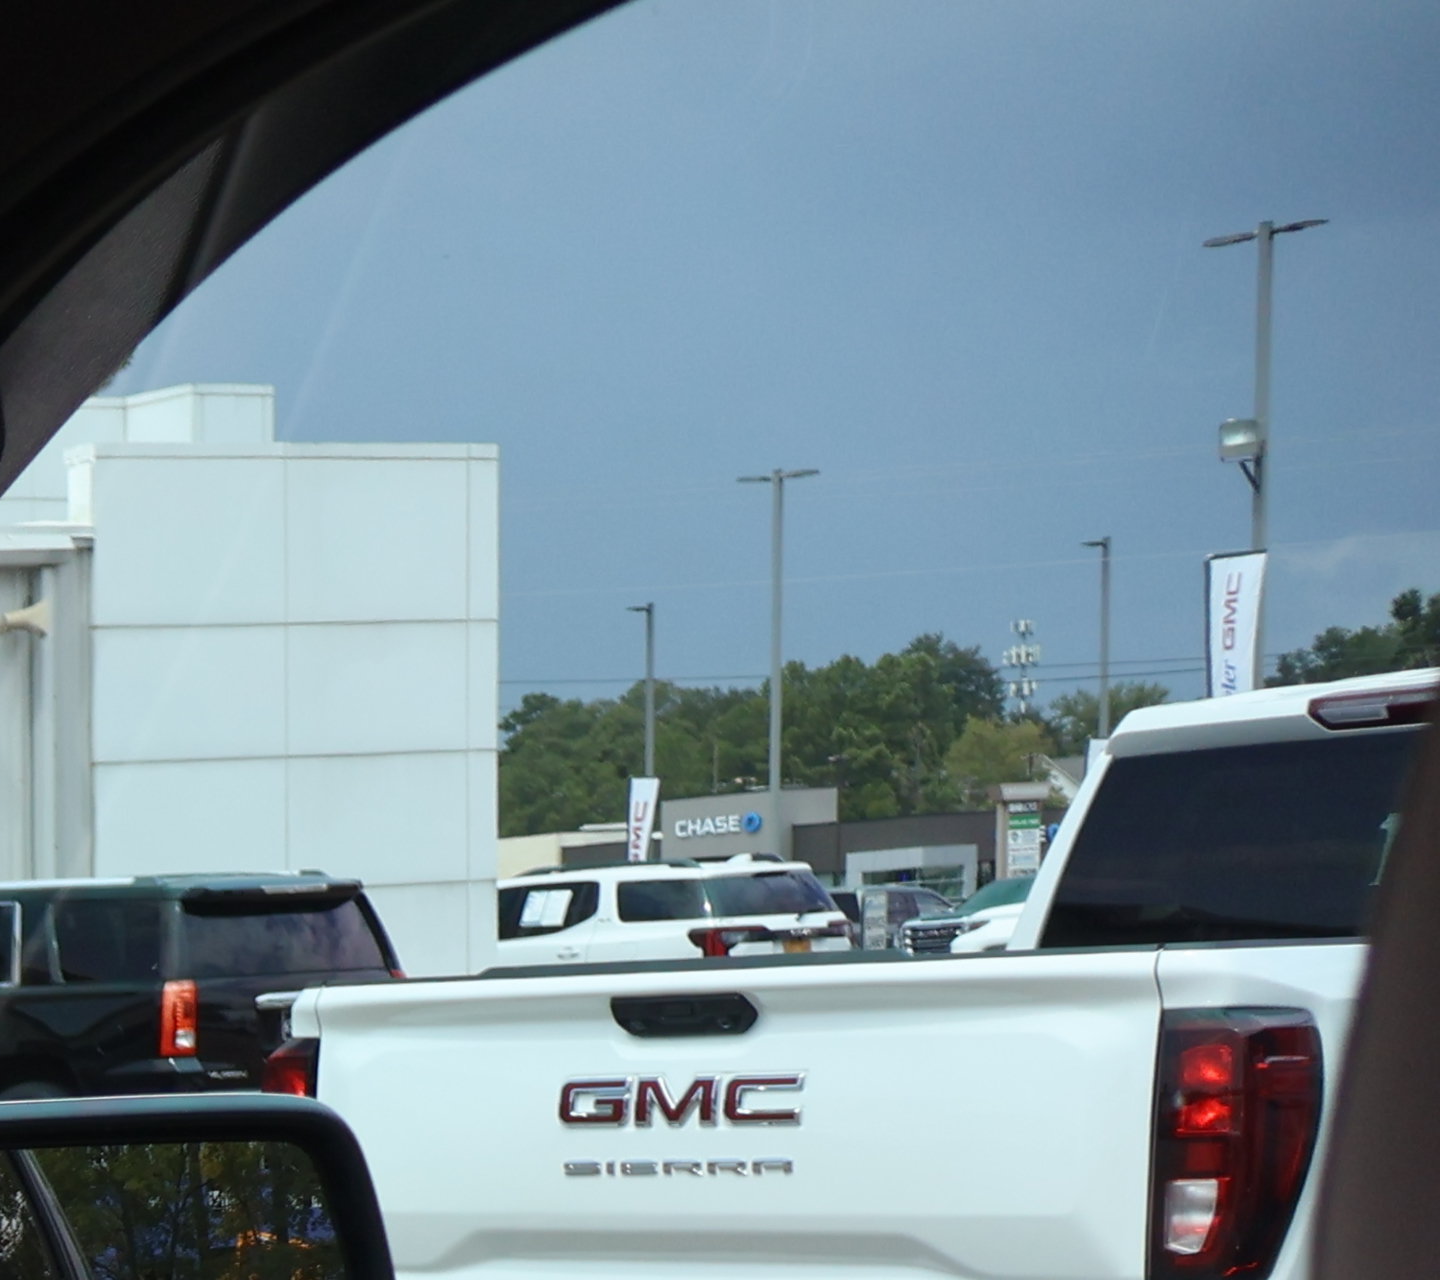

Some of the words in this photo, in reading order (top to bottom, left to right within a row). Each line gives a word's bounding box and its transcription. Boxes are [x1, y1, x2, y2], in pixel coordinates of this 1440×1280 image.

[1222, 571, 1242, 651] GMC
[675, 814, 741, 838] CHASE
[558, 1072, 807, 1128] GMC
[563, 1156, 794, 1176] SIERRA
